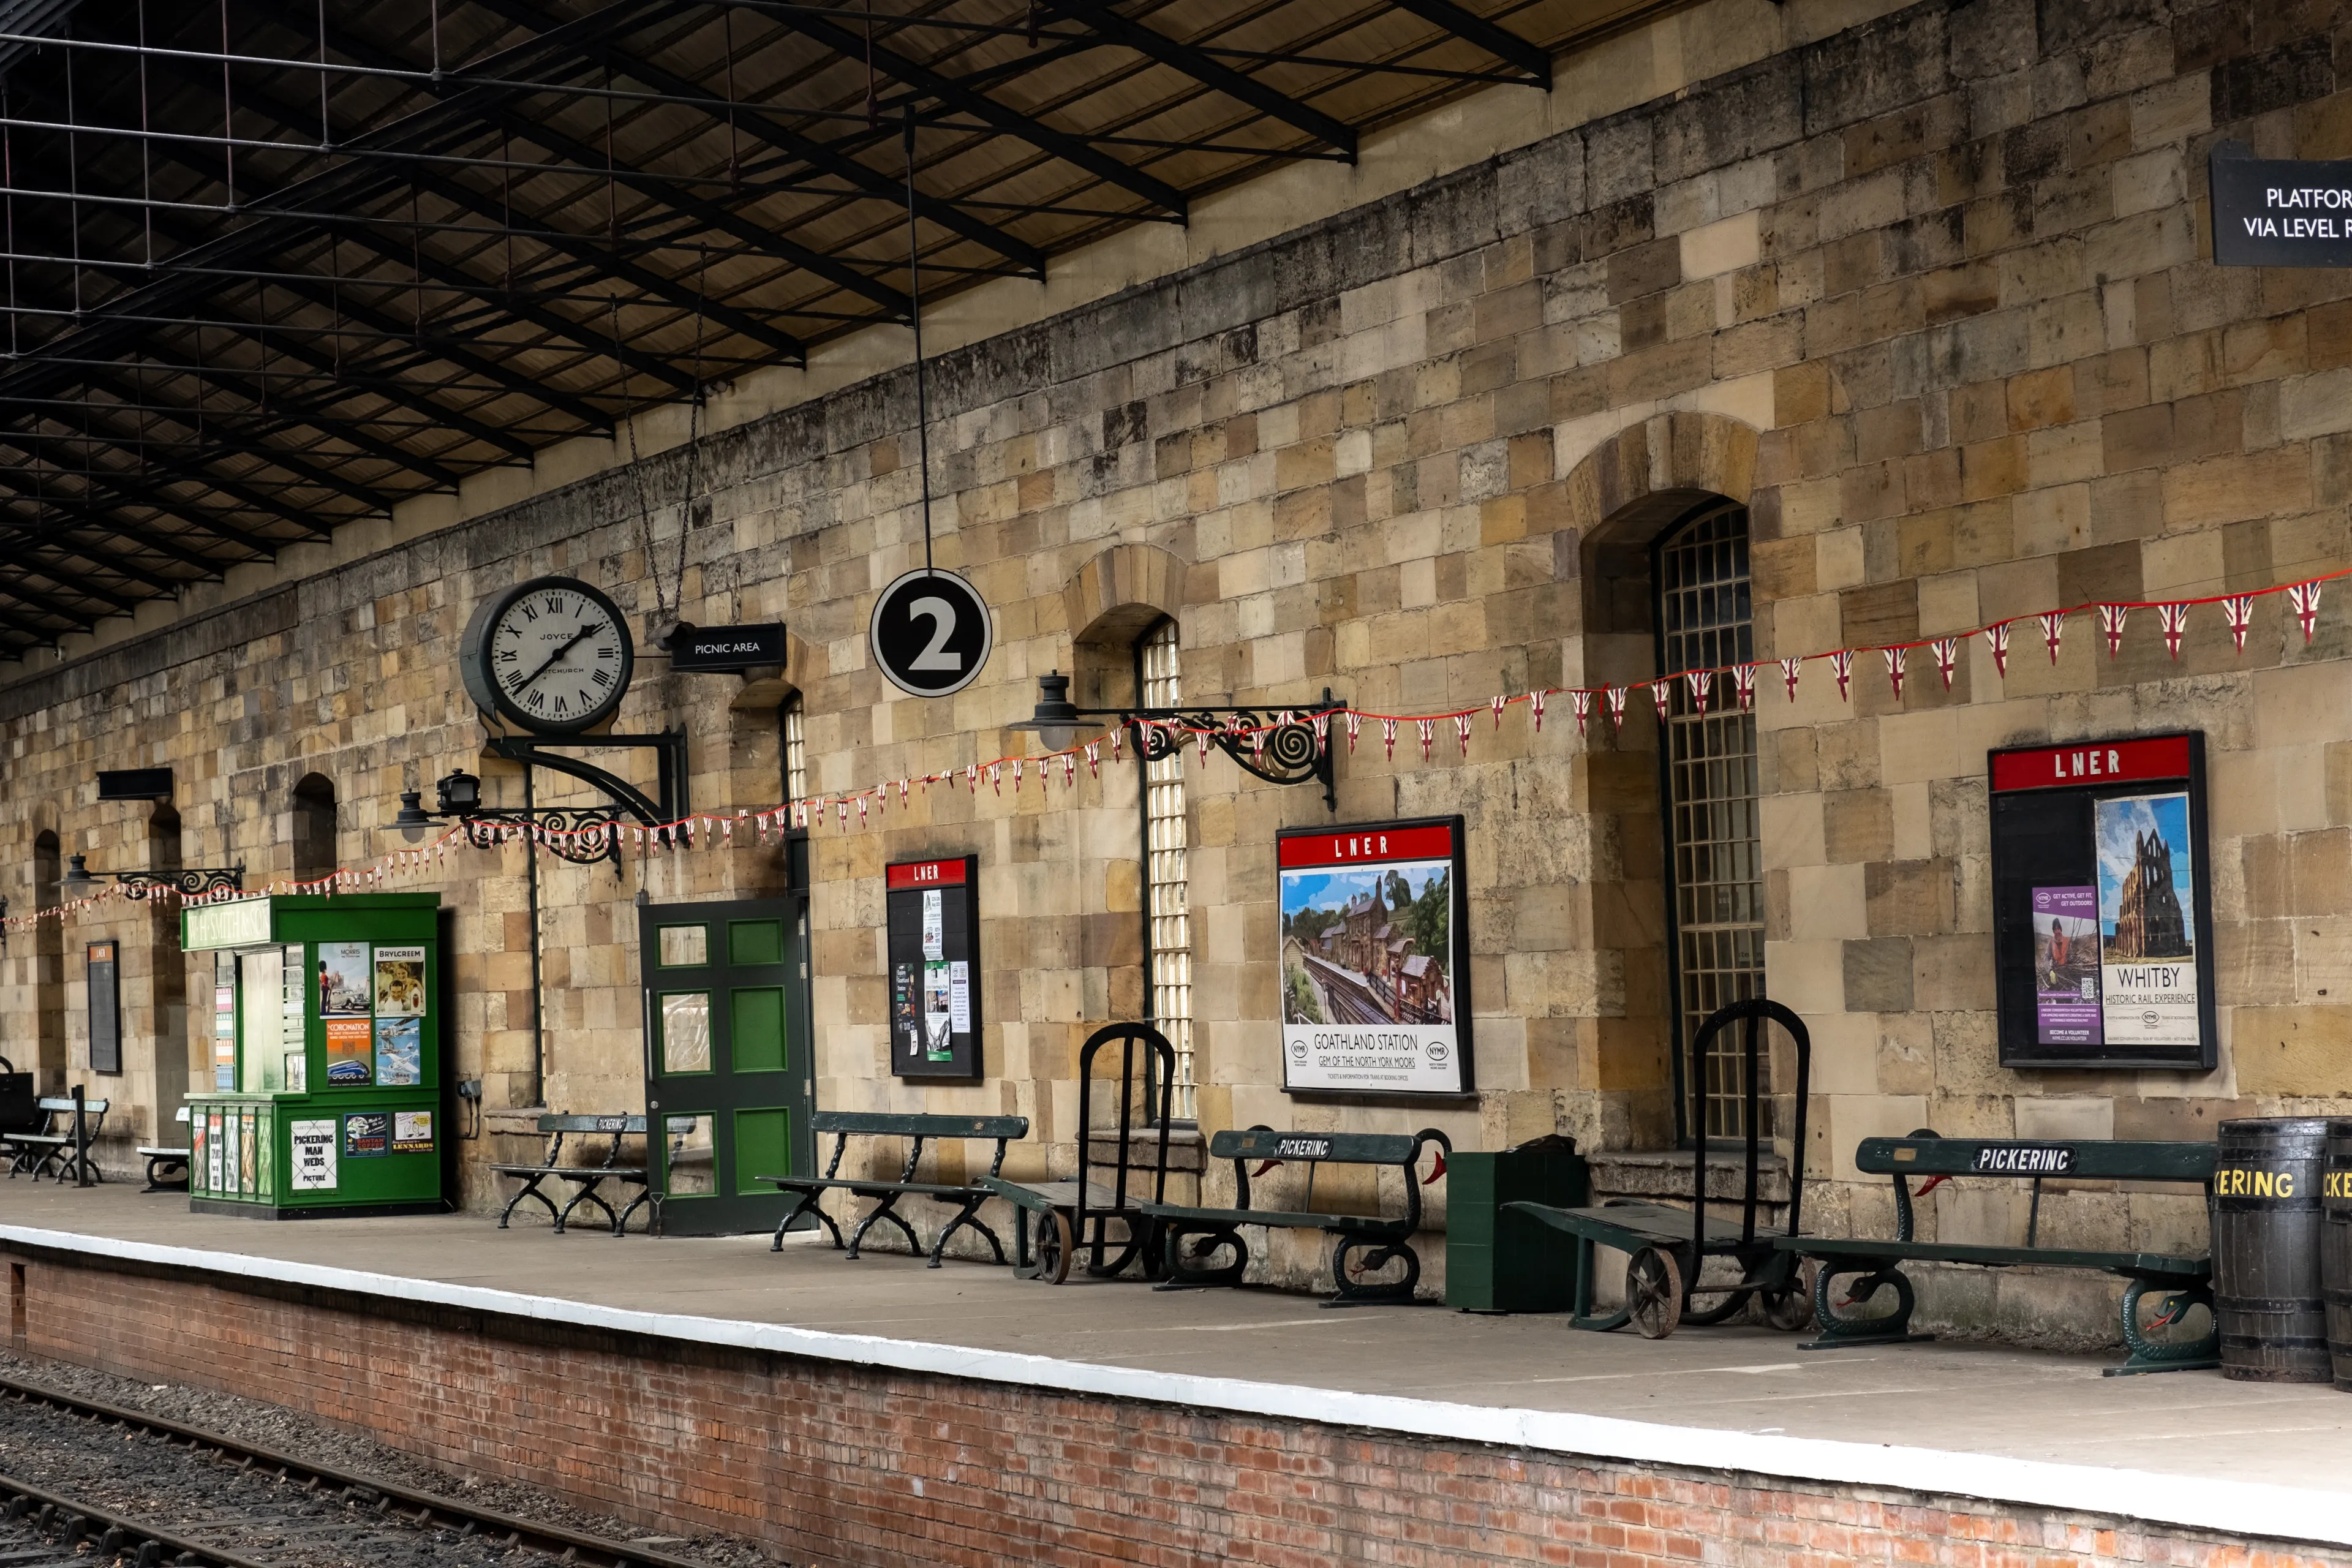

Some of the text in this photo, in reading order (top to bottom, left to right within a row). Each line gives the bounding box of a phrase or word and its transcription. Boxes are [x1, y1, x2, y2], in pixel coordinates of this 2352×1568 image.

[2267, 188, 2352, 208] PLATFOR
[2243, 217, 2278, 237] VIA
[2283, 218, 2339, 238] LEVEL
[908, 596, 961, 670] 2
[695, 642, 760, 654] PICNIC AREA
[2056, 749, 2120, 777] LNER
[1335, 836, 1387, 858] LNER
[914, 864, 939, 881] LNER
[2117, 967, 2180, 987] WHITBY
[2106, 993, 2195, 1003] HISTORIC RAIL EXPERIENCE
[330, 1023, 369, 1031] CORONATION
[1314, 1033, 1418, 1051] GOATHLAND STATION
[1430, 1047, 1446, 1055] NYMR
[1319, 1056, 1415, 1068] GEM OF THE NORTH YORK MOORS
[597, 1118, 624, 1130] PICKERING
[294, 1134, 334, 1145] PICKERING
[1278, 1139, 1329, 1156] PICKERING
[305, 1146, 323, 1155] MAN
[303, 1157, 325, 1167] WEDS
[1979, 1149, 2069, 1171] PICKERING
